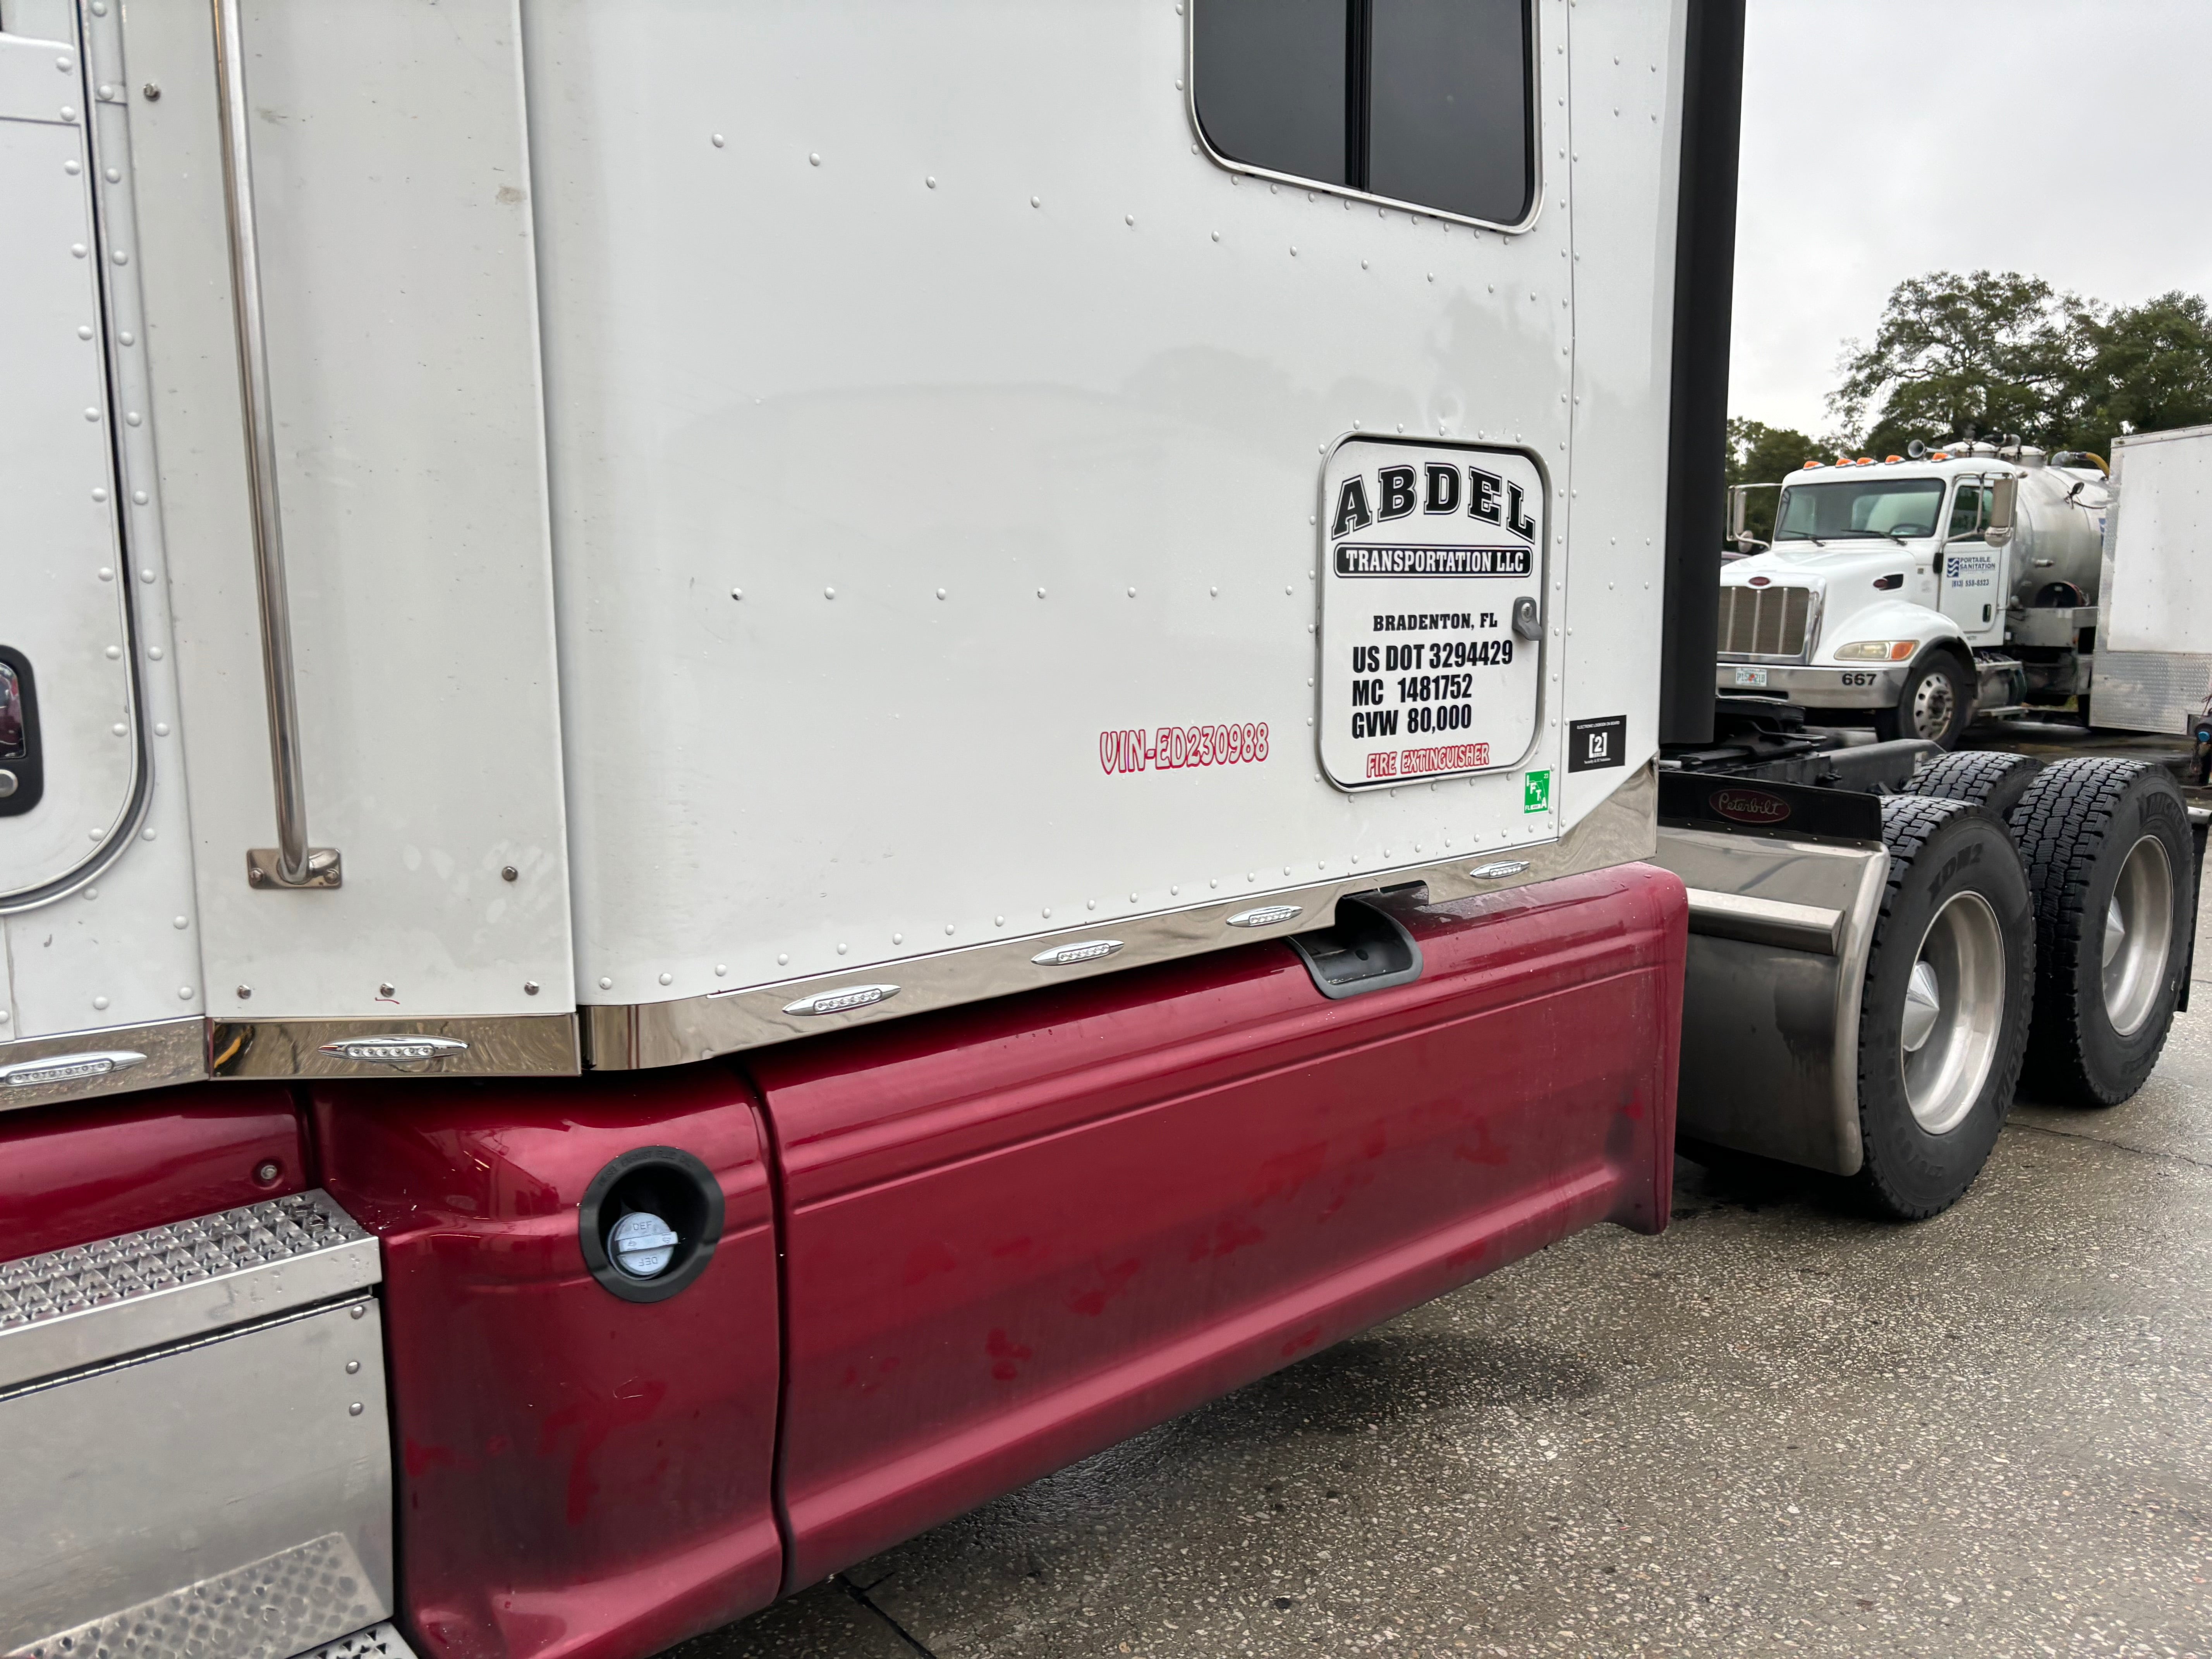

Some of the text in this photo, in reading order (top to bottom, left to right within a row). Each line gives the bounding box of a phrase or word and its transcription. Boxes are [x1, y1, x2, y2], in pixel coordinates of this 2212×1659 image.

[1332, 462, 1535, 545] ABDEL
[1346, 550, 1524, 572] TRANSPORTATION LLC
[1373, 613, 1498, 632] BRADENTON, FL
[1353, 640, 1513, 673] US DOT 3294429
[1352, 673, 1473, 706] MC 1481752
[1842, 673, 1877, 686] 667
[1352, 704, 1472, 739] GVW 80,000
[1100, 722, 1269, 775] VIN-ED230988
[1367, 743, 1489, 778] FIRE EXTINGUISHER
[1719, 793, 1783, 815] Peterbilt
[633, 1221, 652, 1230] DEF
[638, 1257, 658, 1266] DEF
